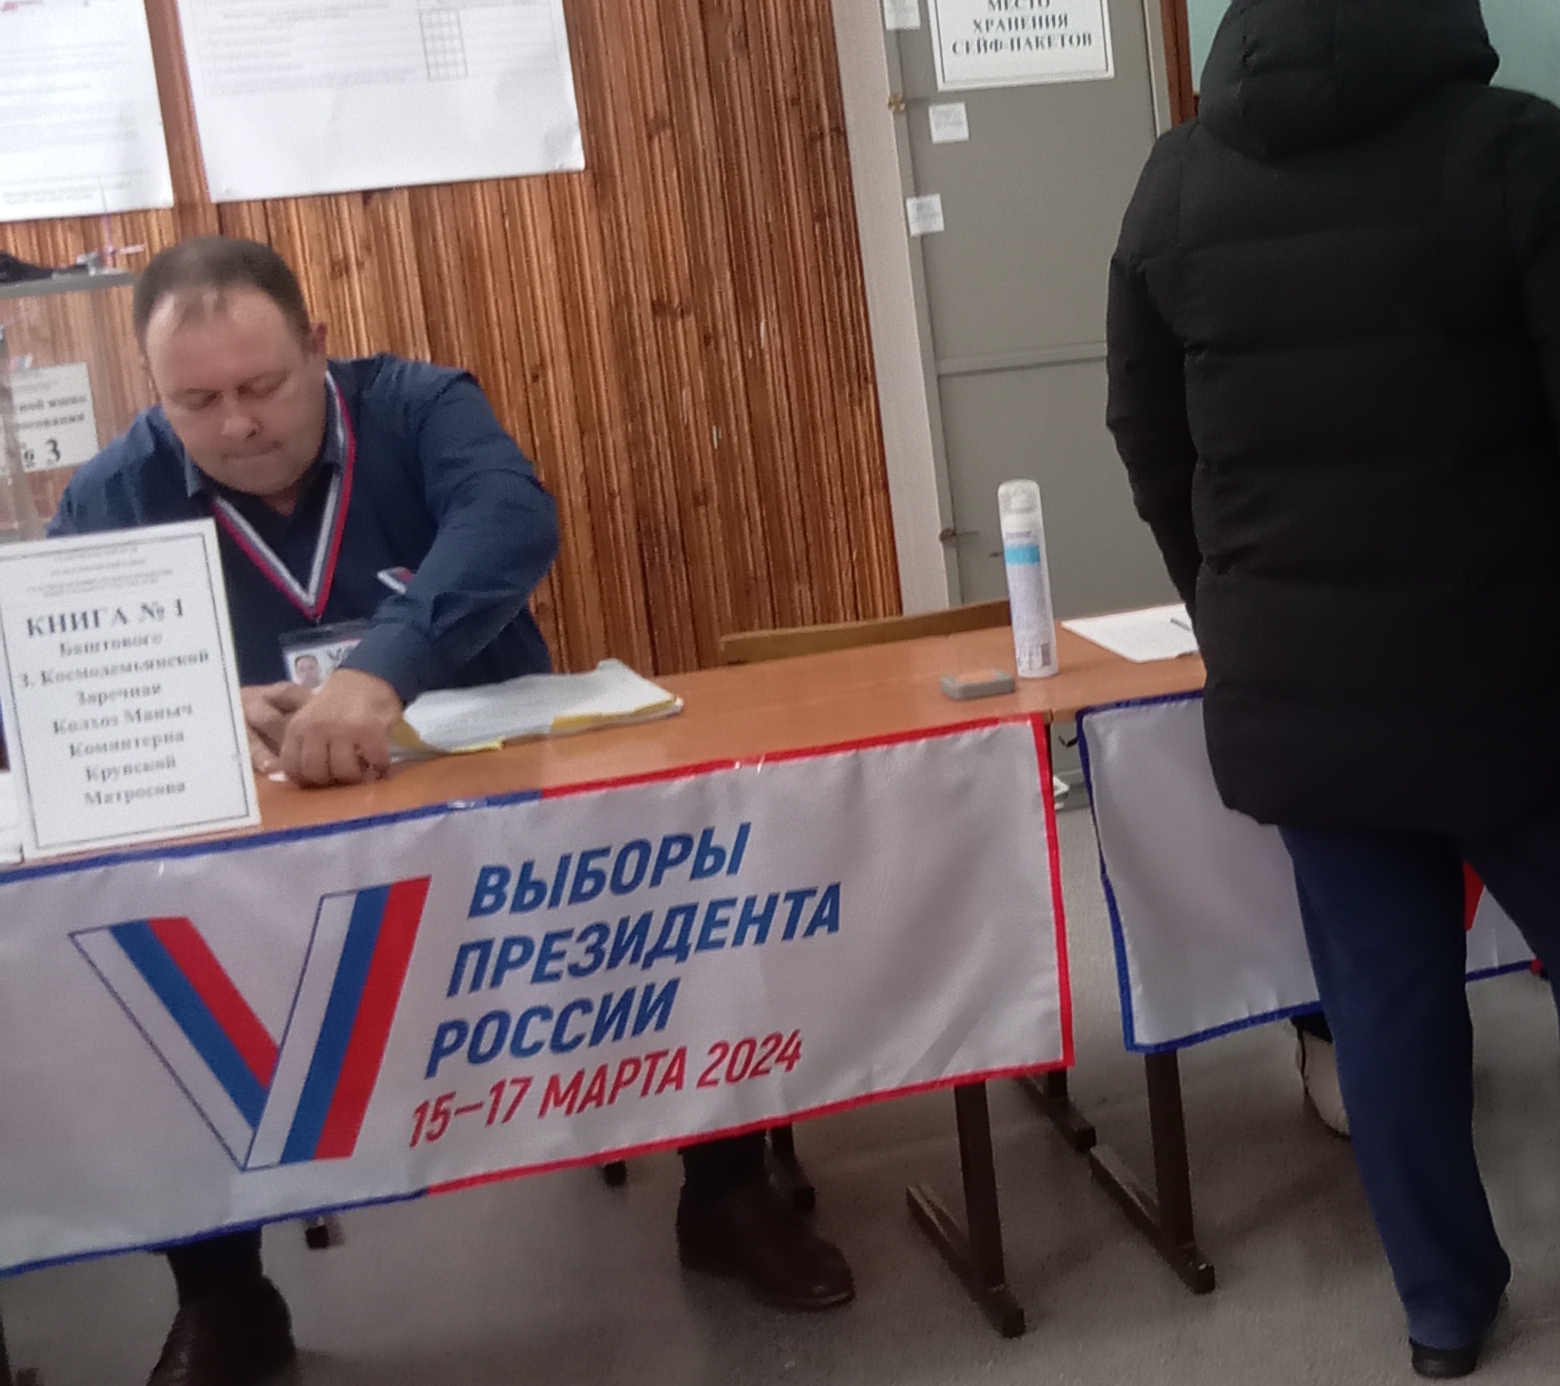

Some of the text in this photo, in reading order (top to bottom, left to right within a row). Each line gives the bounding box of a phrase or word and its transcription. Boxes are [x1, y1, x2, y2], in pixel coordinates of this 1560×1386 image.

[973, 13, 1068, 33] ХРАНЕНИЯ
[27, 608, 128, 636] КНИГА
[467, 822, 751, 919] ВЫБОРЫ
[446, 882, 841, 998] ПРЕЗИДЕНТА
[424, 978, 680, 1079] РОССИИ
[538, 1047, 685, 1119] МАРТА
[696, 1028, 804, 1089] 2024
